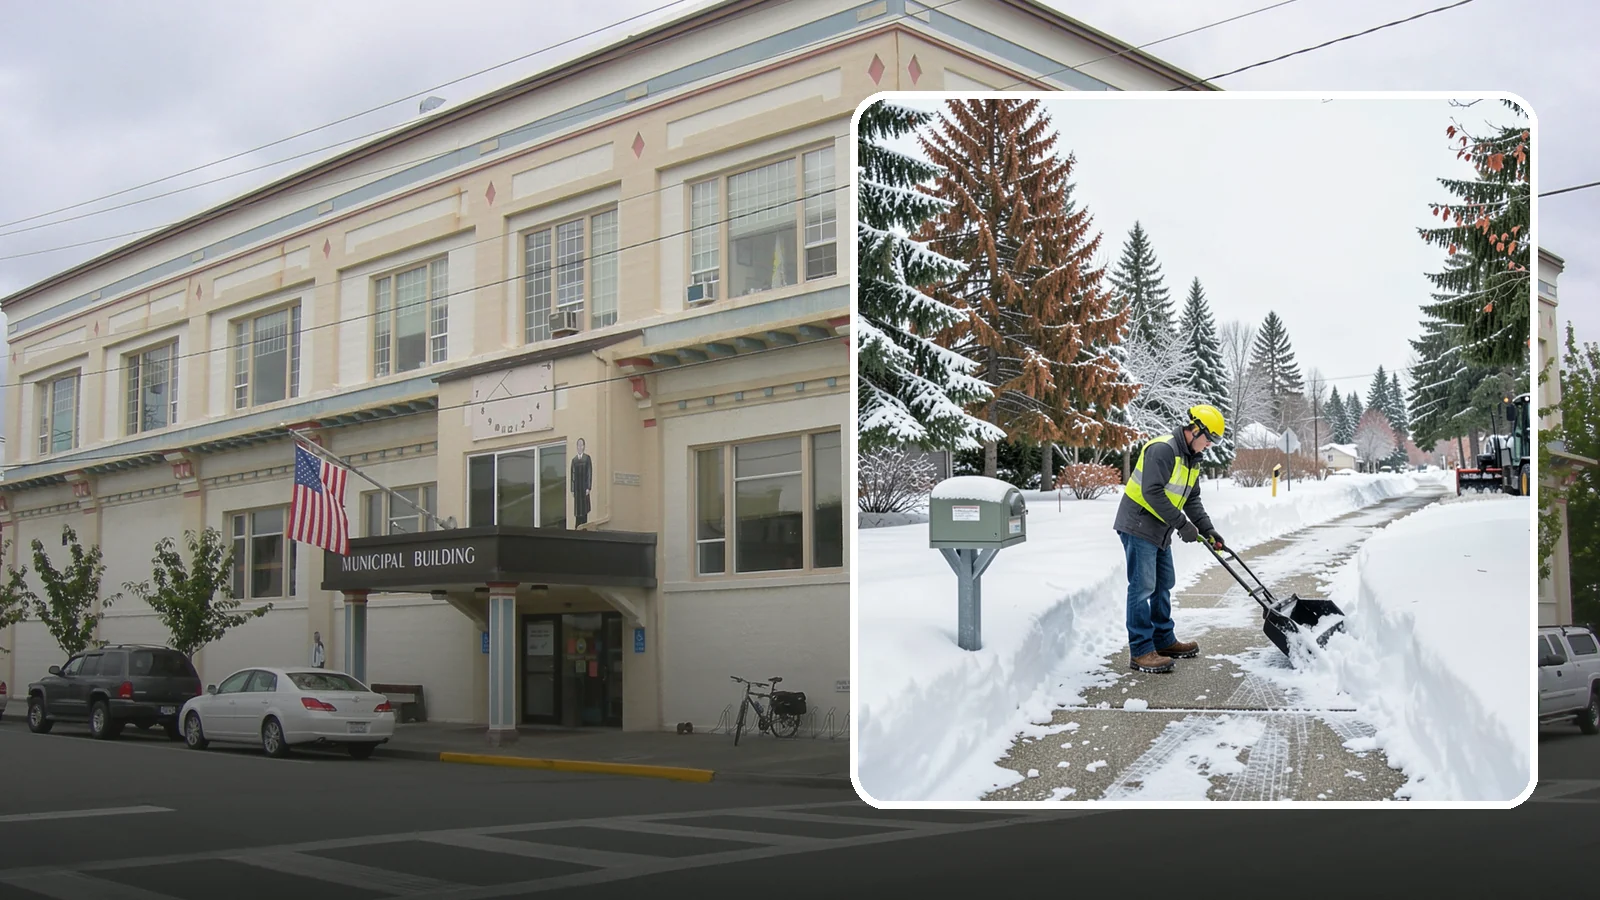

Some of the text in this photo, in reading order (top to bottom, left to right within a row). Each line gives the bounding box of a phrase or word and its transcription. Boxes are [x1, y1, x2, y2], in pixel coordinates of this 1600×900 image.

[481, 406, 485, 415] 8
[536, 402, 540, 410] 4
[529, 413, 533, 422] 3
[488, 417, 492, 426] 9
[495, 423, 500, 432] 10
[501, 425, 506, 433] 11
[507, 425, 513, 433] 12
[521, 420, 525, 428] 2
[342, 546, 475, 571] MUNICIPAL BUILDING
